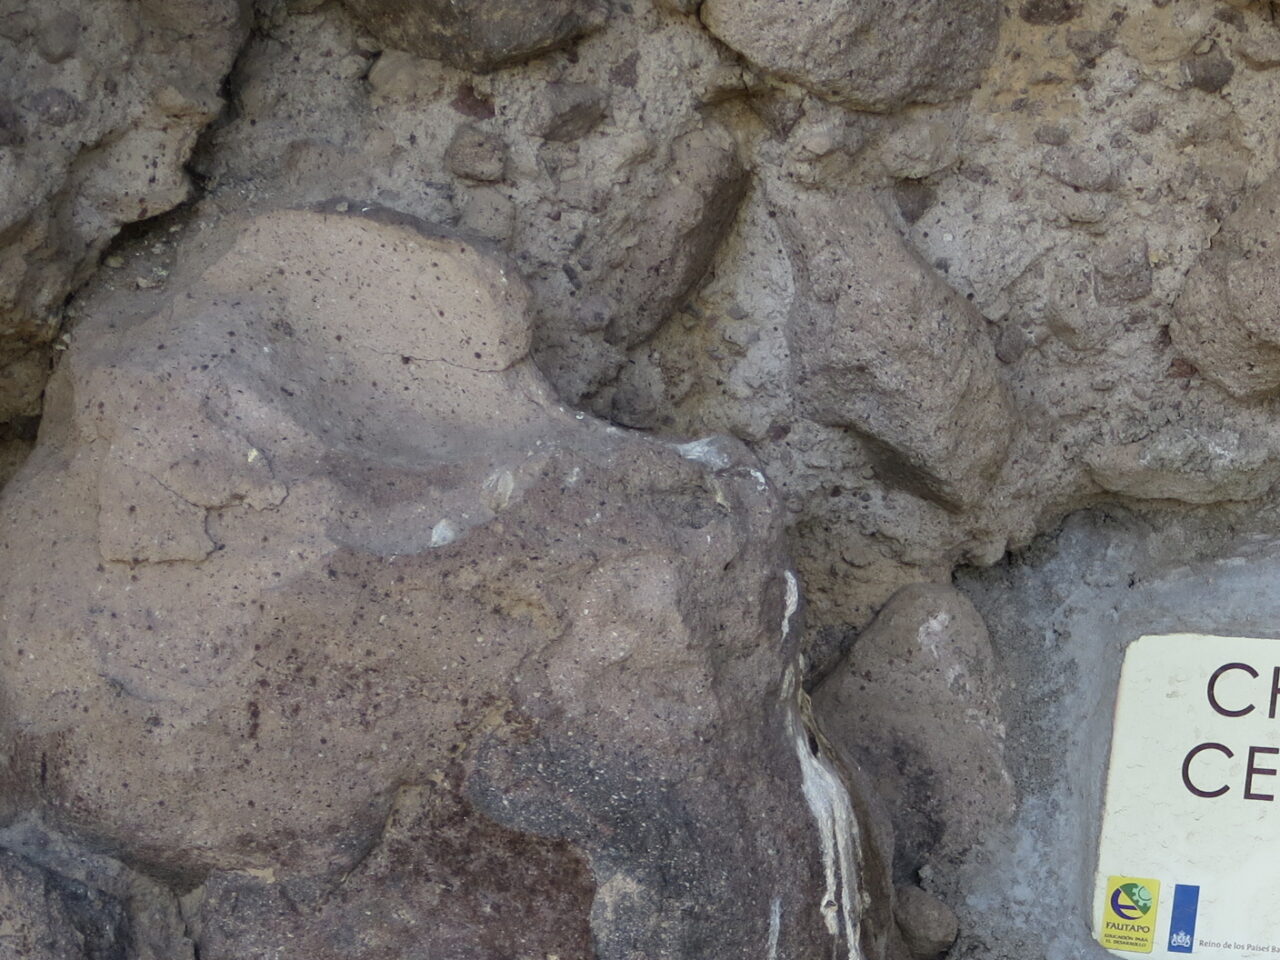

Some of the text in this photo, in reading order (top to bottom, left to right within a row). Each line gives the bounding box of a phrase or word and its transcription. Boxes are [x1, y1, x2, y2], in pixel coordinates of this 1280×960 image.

[1105, 921, 1150, 934] FAUTAPO
[1199, 939, 1221, 948] Reino
[1223, 941, 1232, 949] de
[1233, 942, 1245, 950] los
